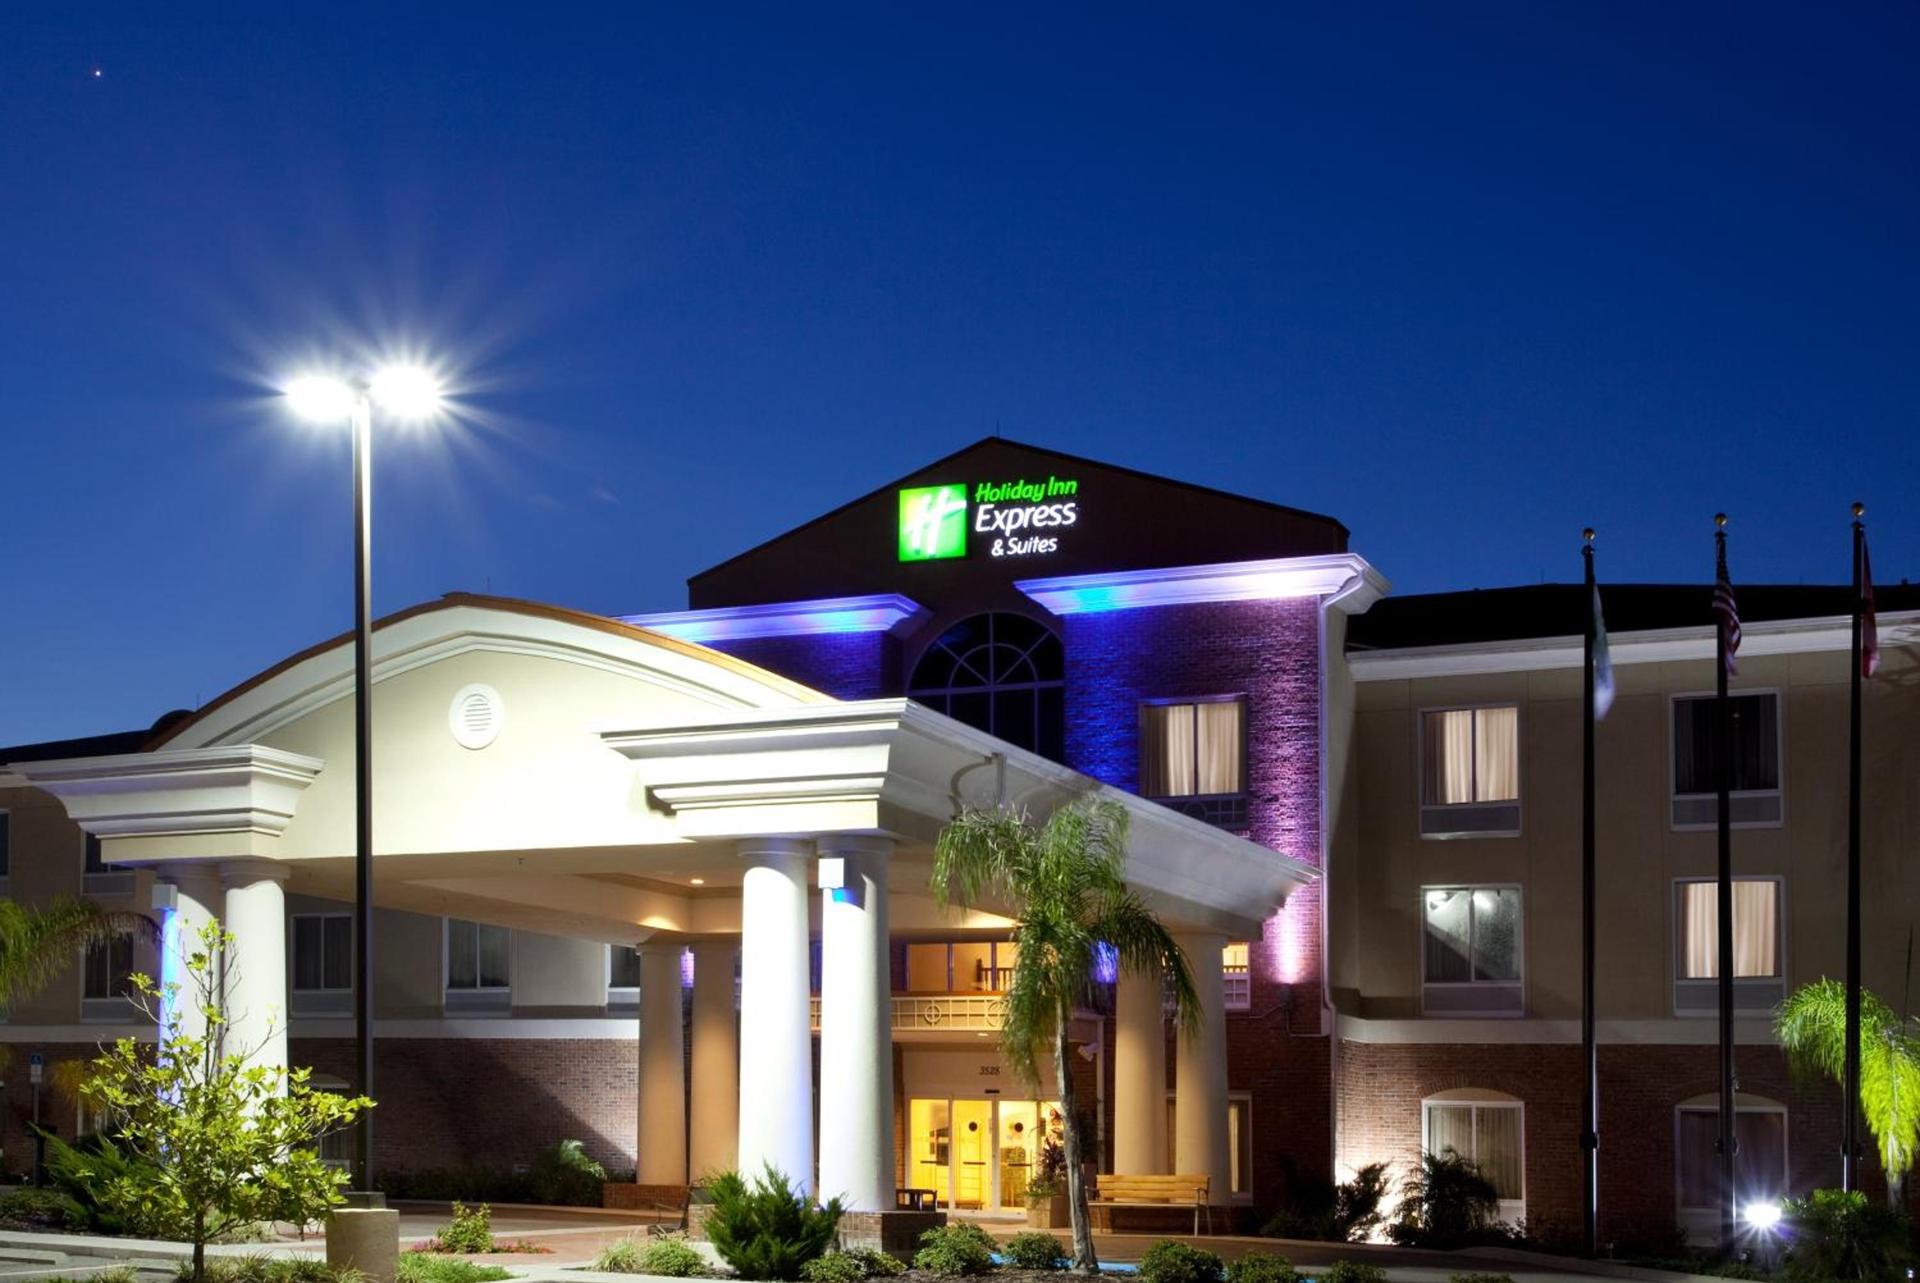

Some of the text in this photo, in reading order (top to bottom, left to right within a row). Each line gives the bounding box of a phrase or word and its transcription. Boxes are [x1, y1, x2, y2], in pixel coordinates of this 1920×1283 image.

[975, 476, 1077, 502] Holiday Inn
[975, 502, 1077, 537] Express
[991, 537, 1058, 556] & Suites
